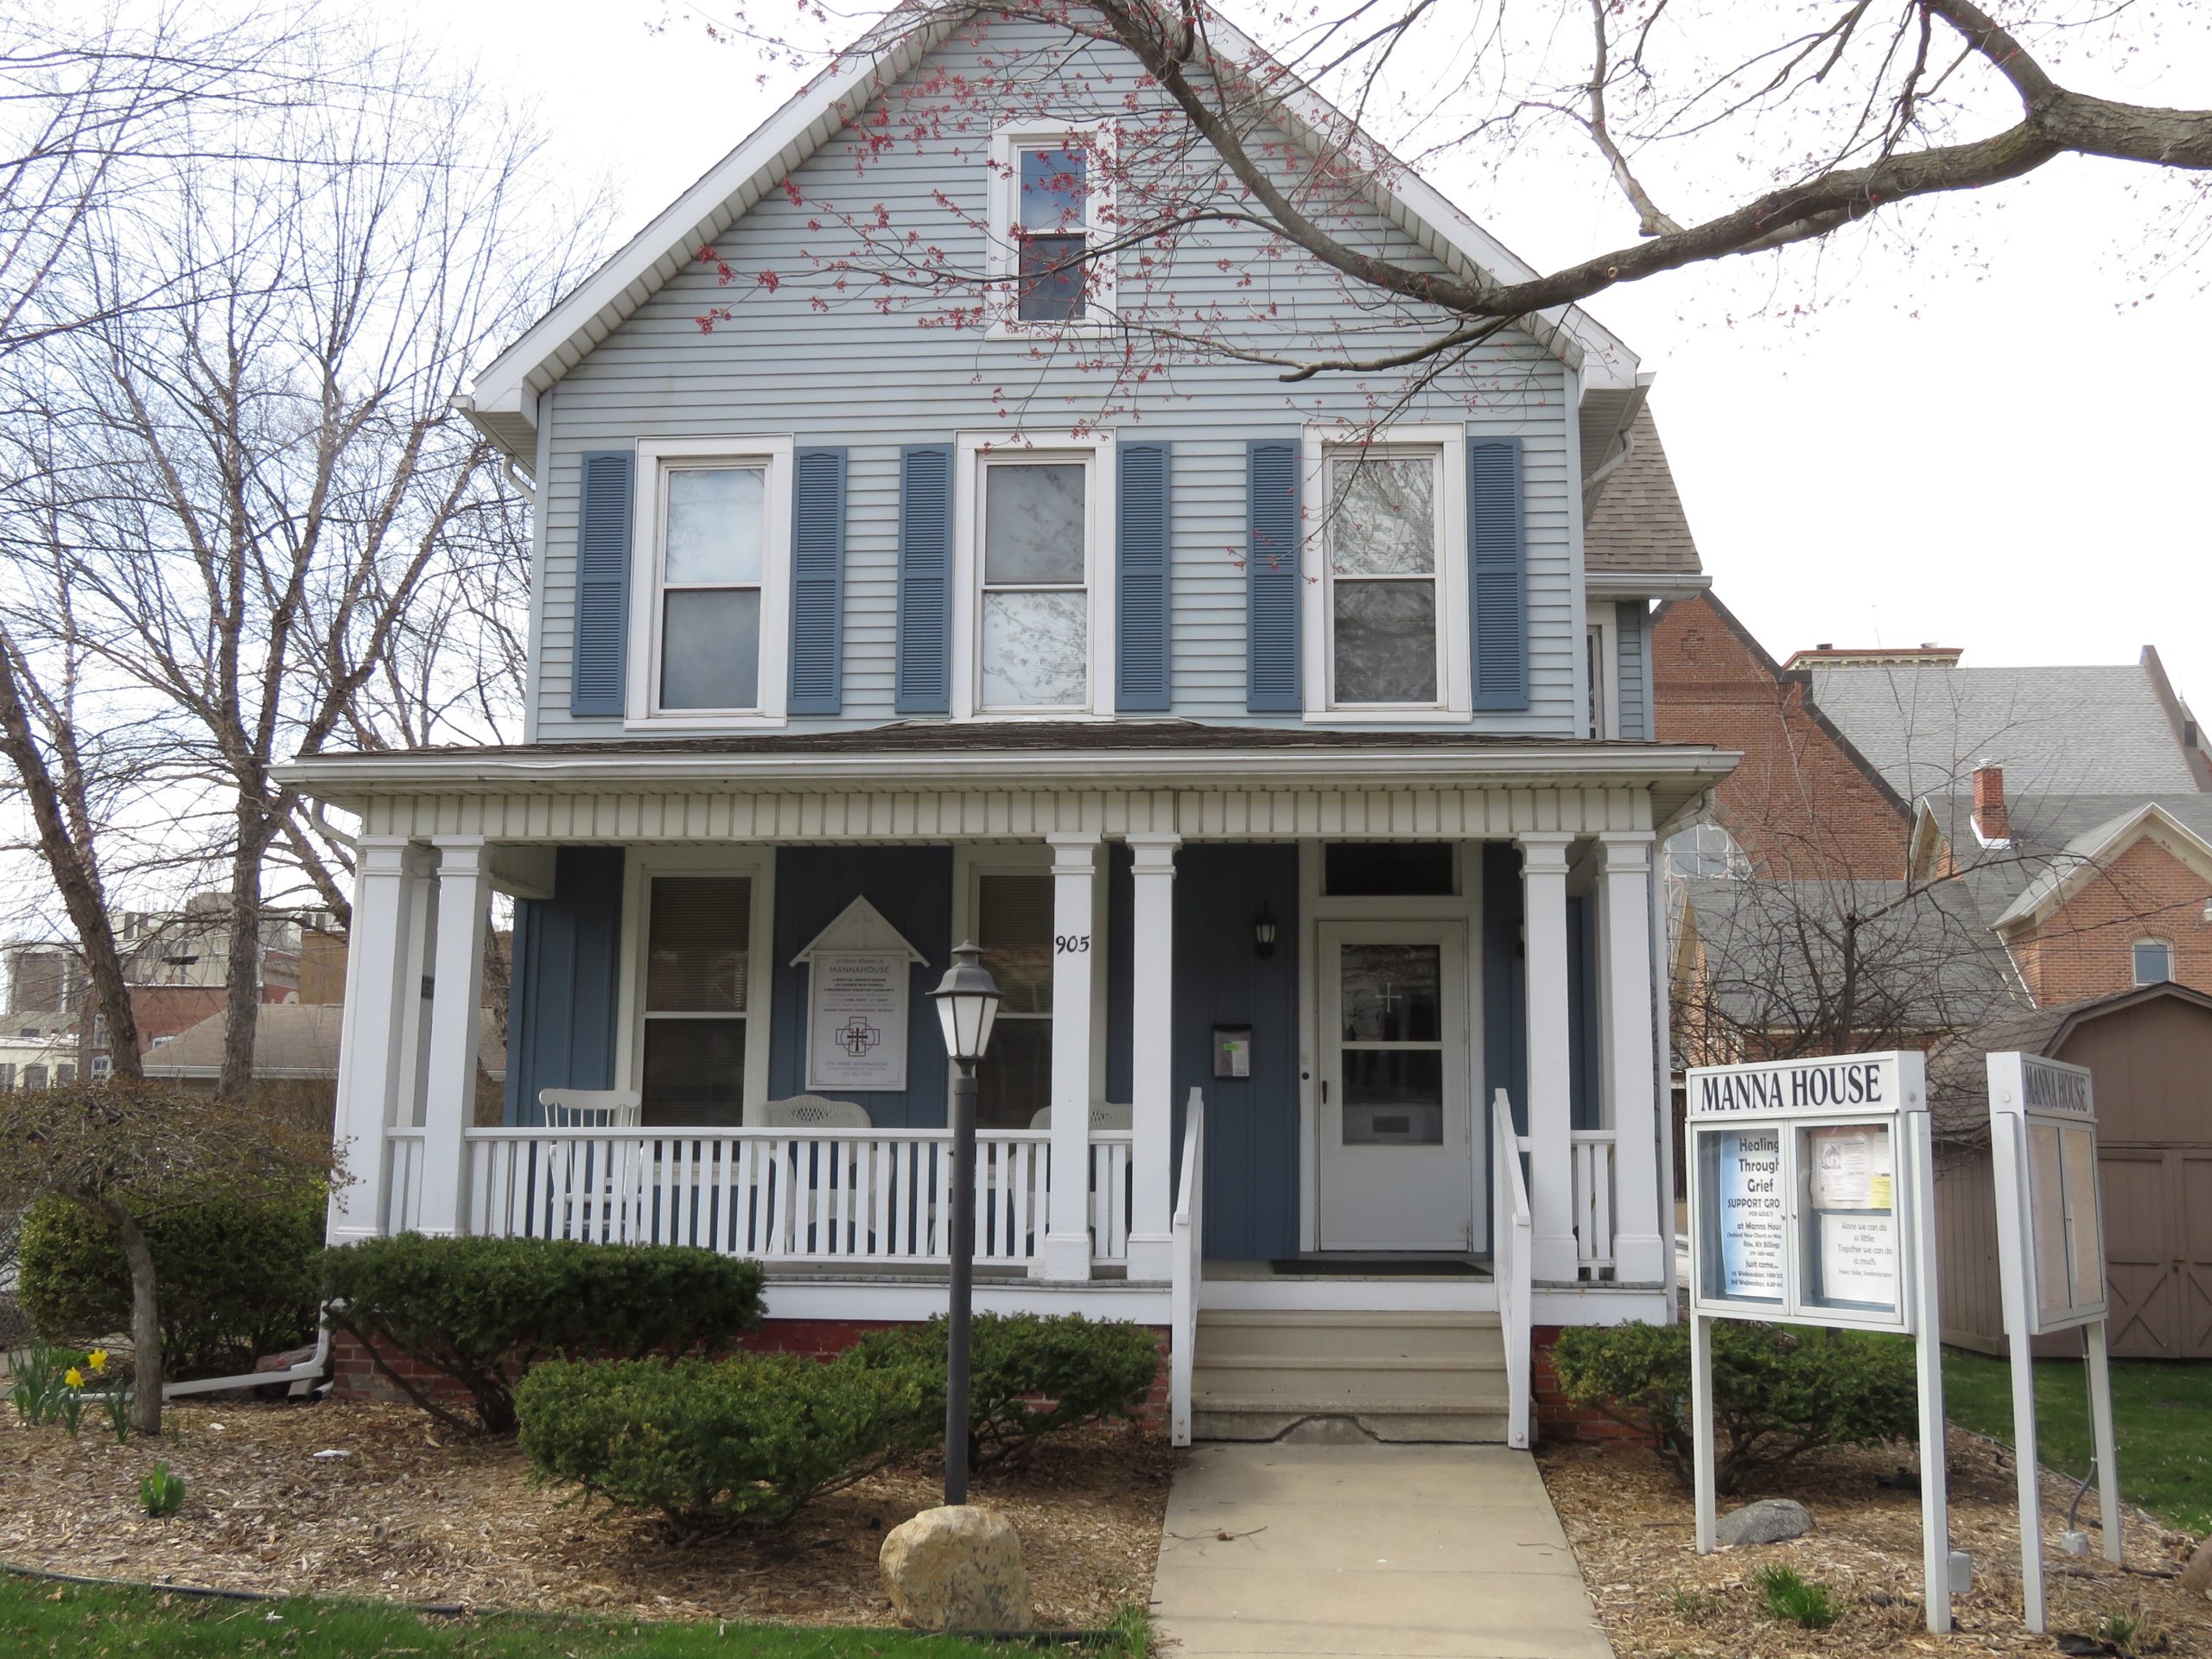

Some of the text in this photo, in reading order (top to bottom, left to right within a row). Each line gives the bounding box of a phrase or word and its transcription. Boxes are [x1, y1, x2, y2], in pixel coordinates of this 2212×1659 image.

[1056, 936, 1090, 955] 905
[1701, 1065, 1882, 1111] MANNA HOUSE
[2025, 1065, 2088, 1112] MANNA HOUSE
[1739, 1137, 1779, 1154] Healing
[1748, 1178, 1774, 1192] Grief
[1728, 1198, 1780, 1209] SUPPORT GRO
[1737, 1222, 1745, 1230] at
[1745, 1222, 1766, 1230] Manna
[1841, 1221, 1857, 1230] Alone
[1838, 1244, 1861, 1254] Together
[1745, 1260, 1758, 1268] Just
